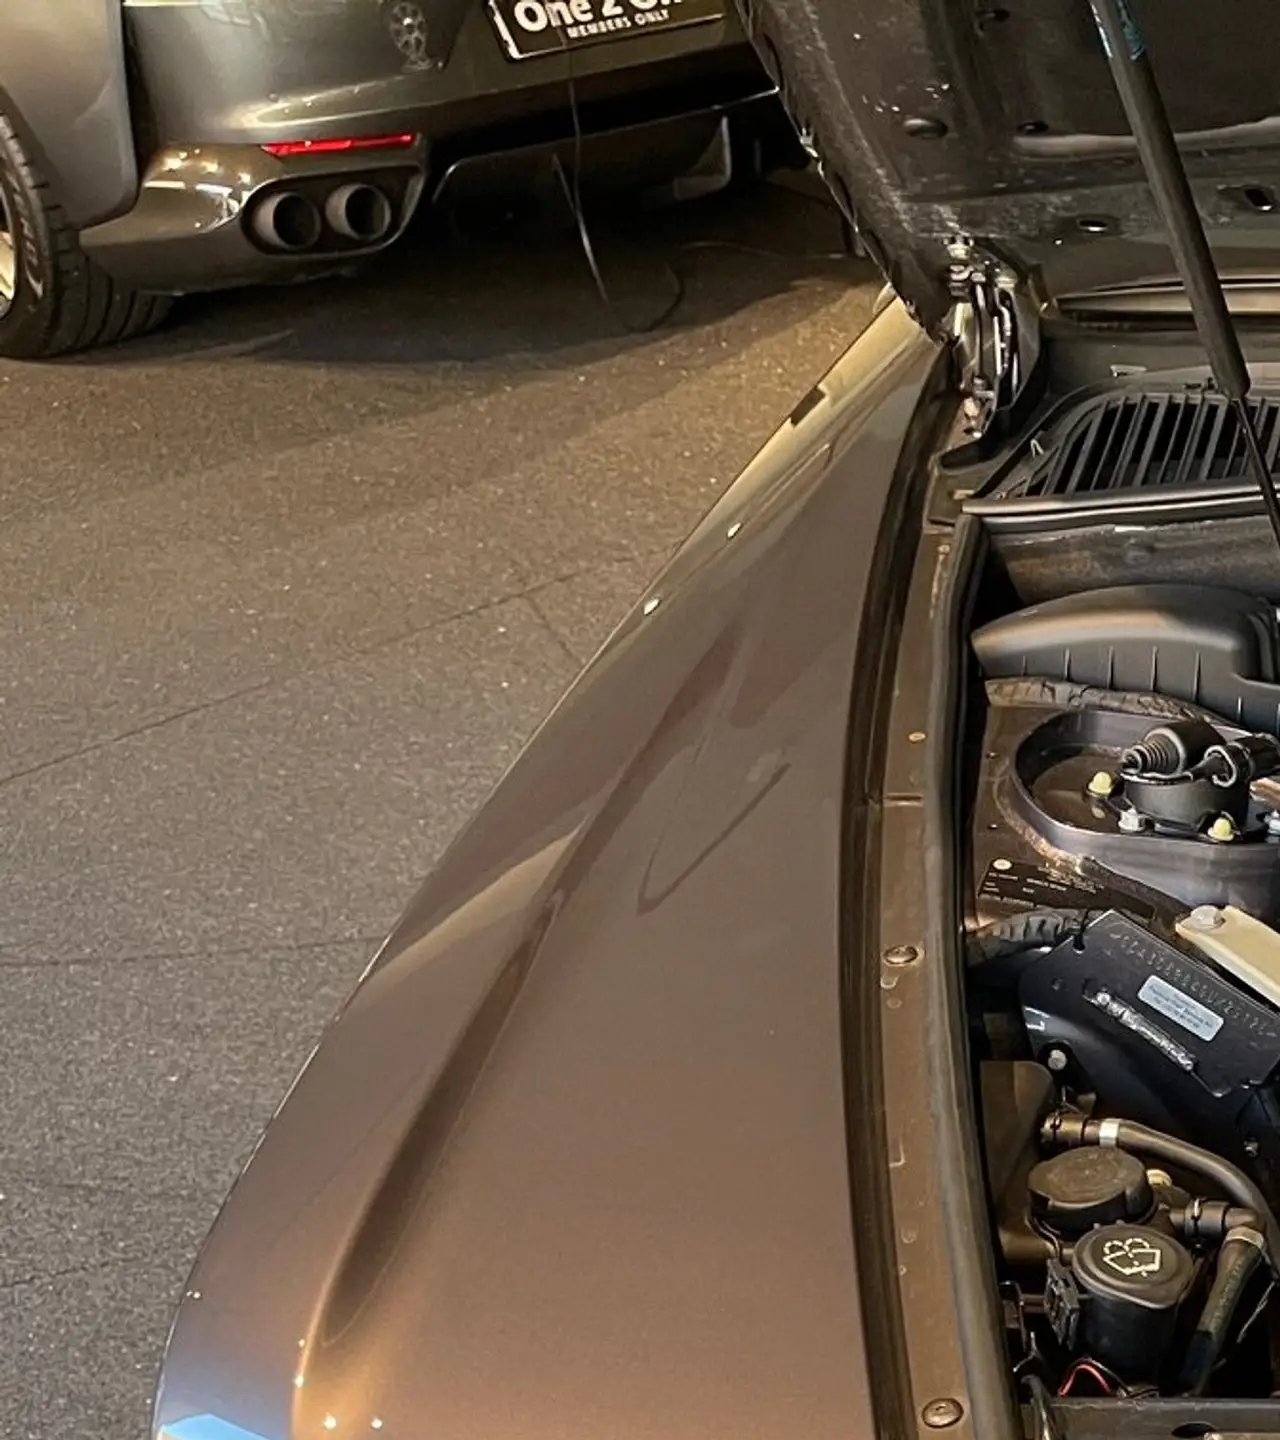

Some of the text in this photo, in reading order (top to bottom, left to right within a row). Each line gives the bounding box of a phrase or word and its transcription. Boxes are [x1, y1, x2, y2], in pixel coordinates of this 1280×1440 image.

[514, 0, 593, 31] One
[565, 9, 669, 38] MEMBERS ONLY
